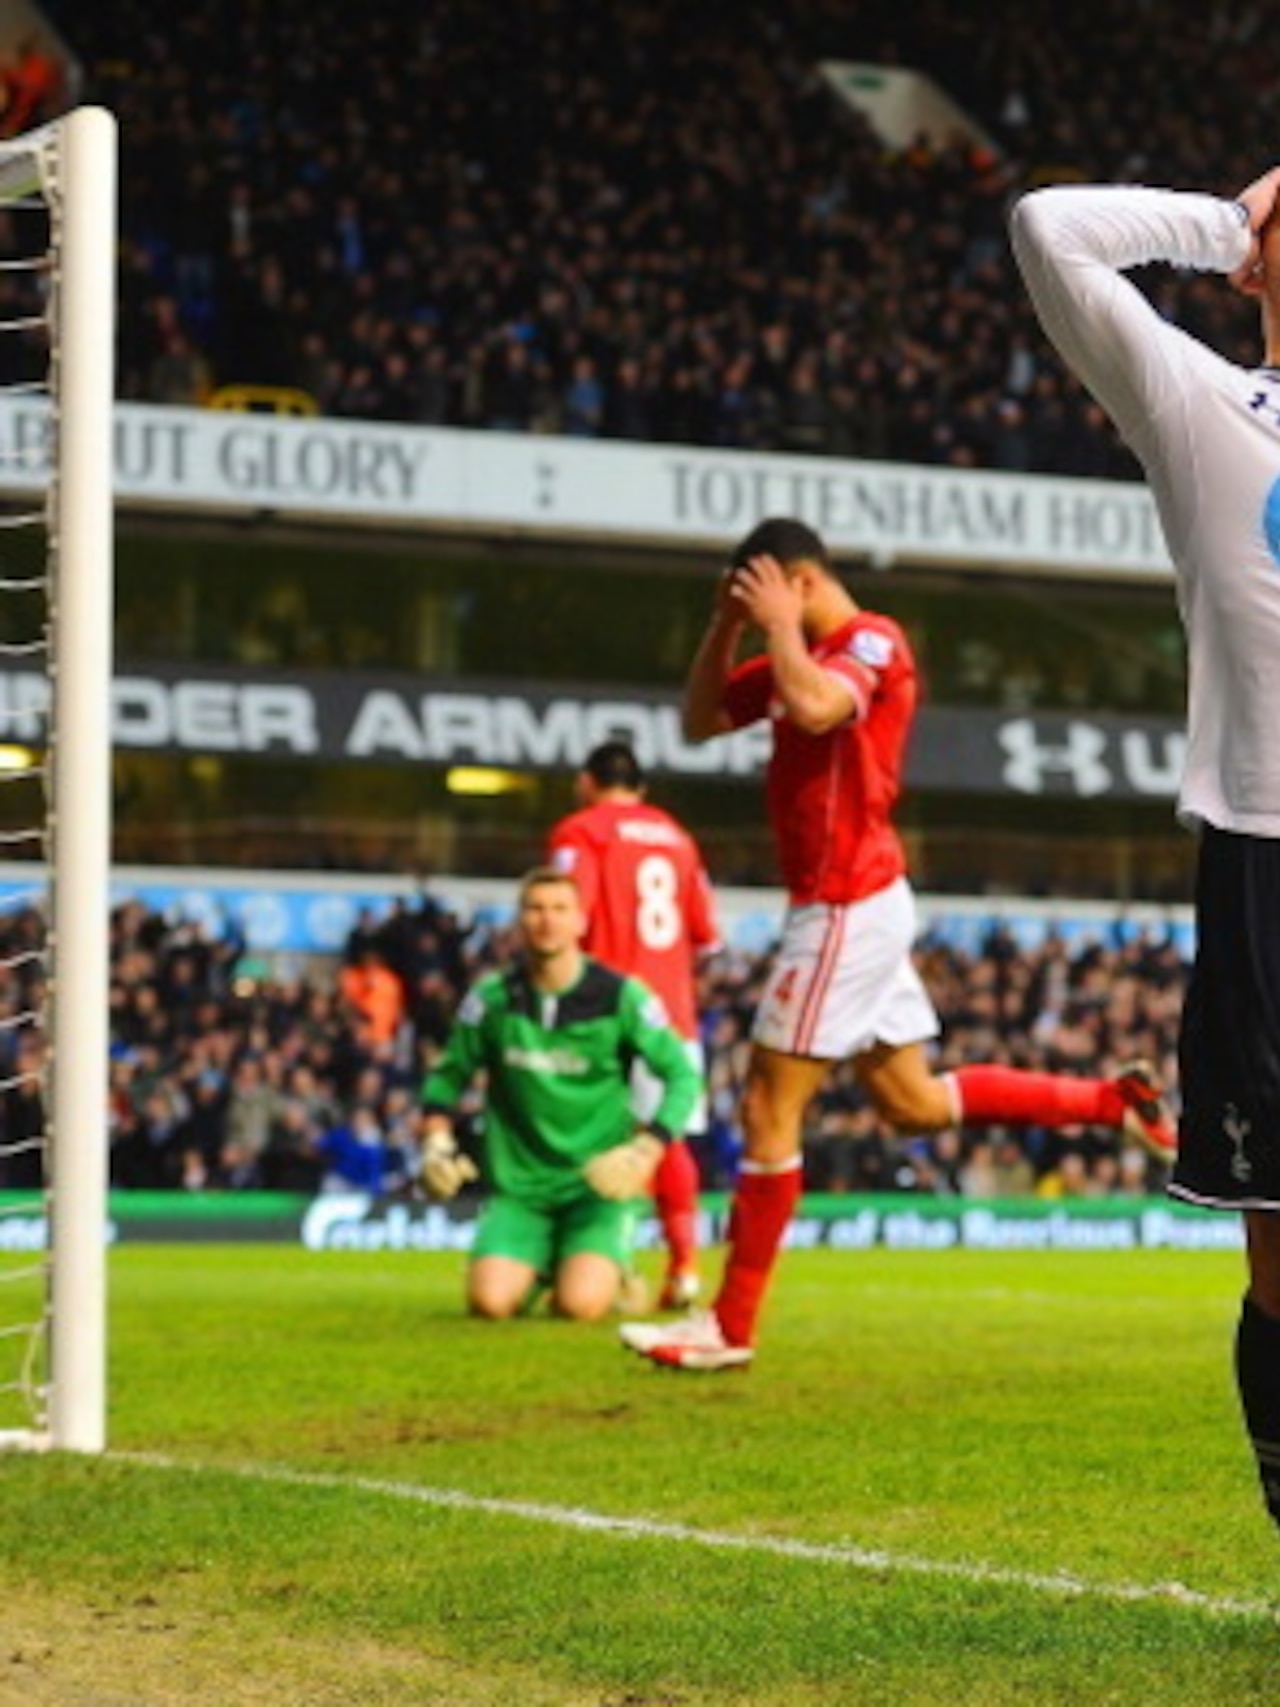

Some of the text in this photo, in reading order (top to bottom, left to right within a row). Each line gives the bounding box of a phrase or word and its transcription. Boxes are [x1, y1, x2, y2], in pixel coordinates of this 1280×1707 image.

[217, 425, 428, 500] GLORY
[664, 461, 1028, 546] TOTTENHAM
[635, 854, 684, 952] 8
